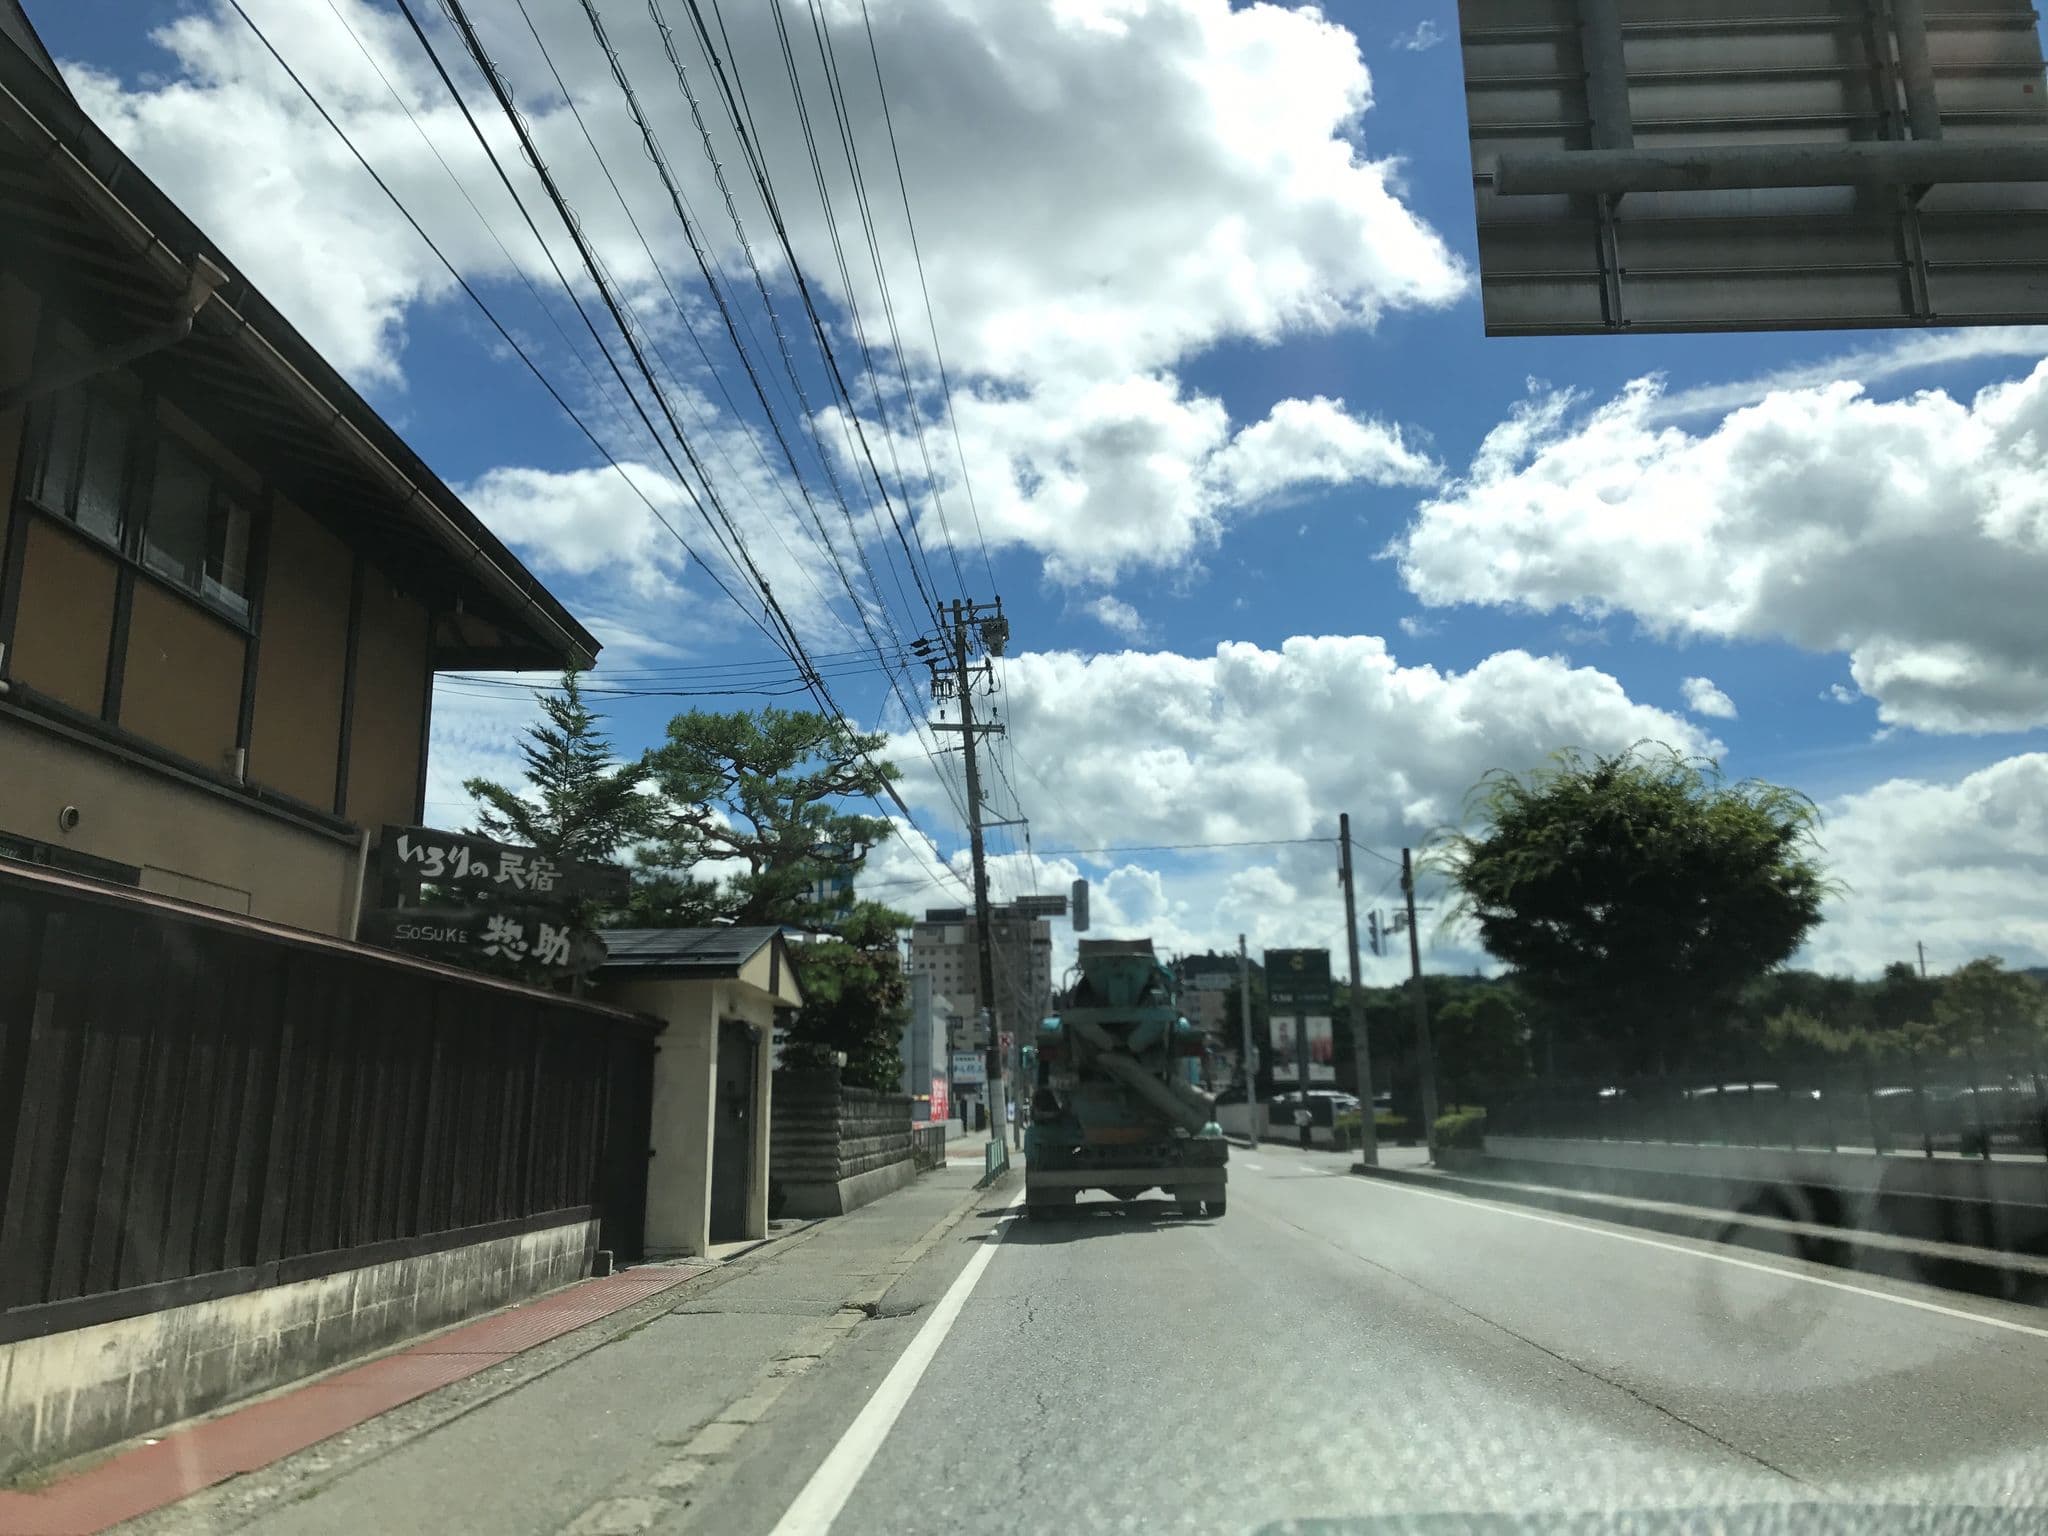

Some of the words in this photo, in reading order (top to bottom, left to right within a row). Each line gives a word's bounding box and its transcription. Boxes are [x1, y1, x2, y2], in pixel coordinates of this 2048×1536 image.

[397, 835, 562, 891] いろりの民宿
[481, 914, 571, 966] 惣助
